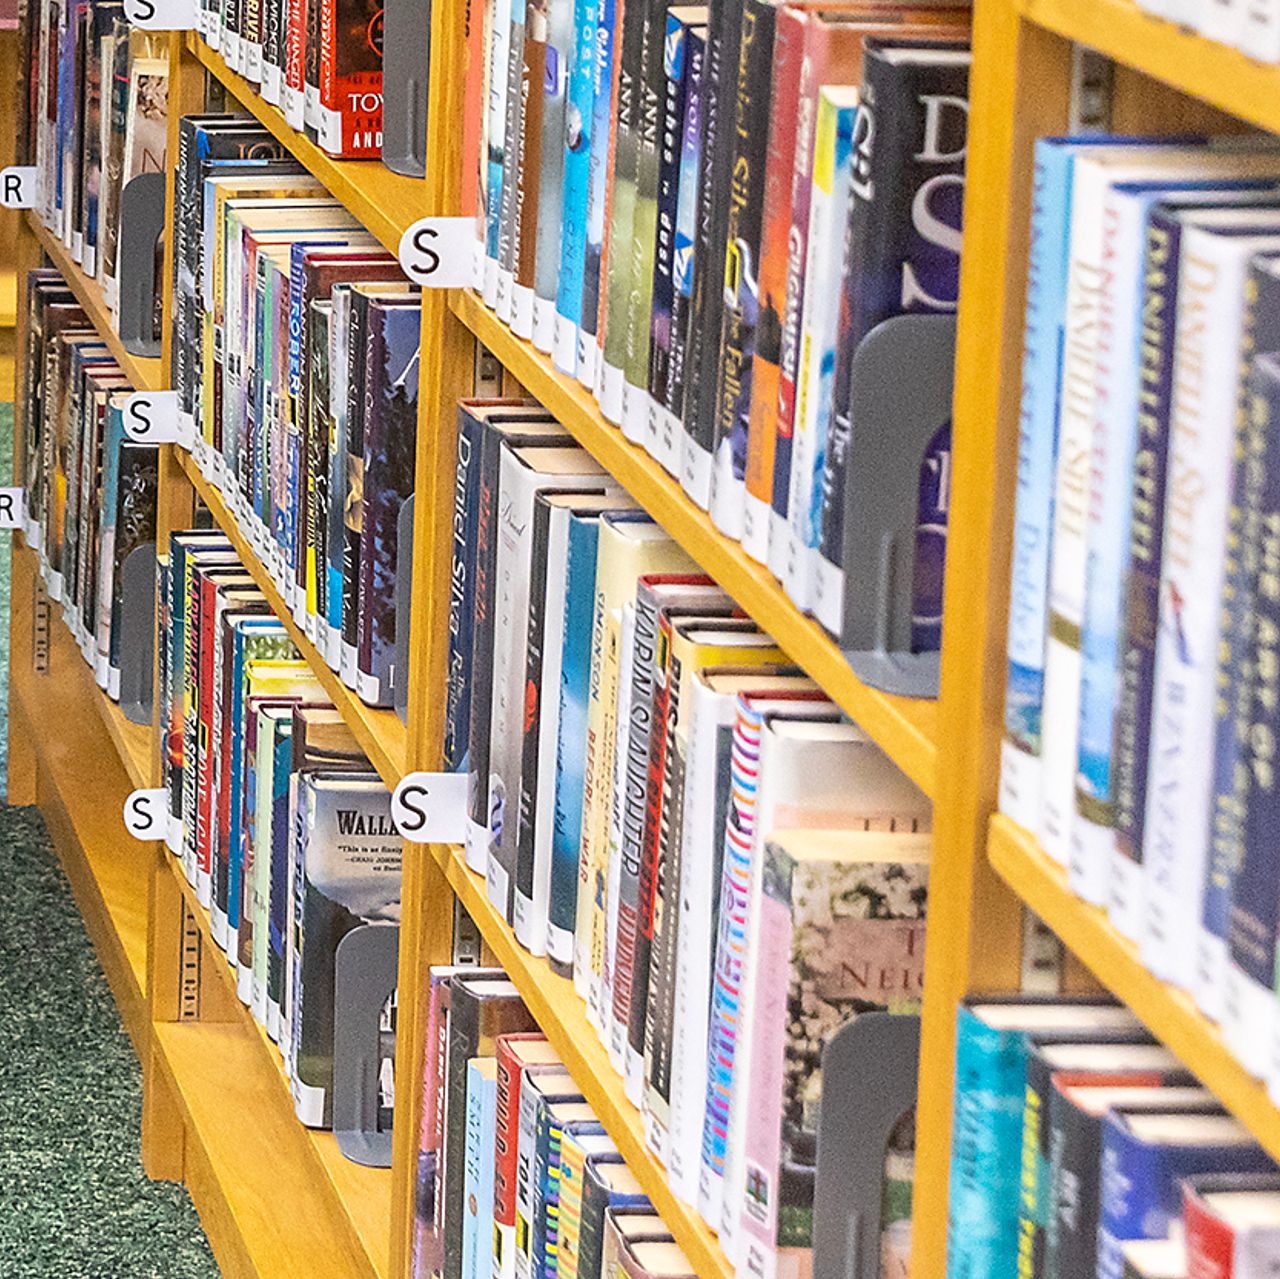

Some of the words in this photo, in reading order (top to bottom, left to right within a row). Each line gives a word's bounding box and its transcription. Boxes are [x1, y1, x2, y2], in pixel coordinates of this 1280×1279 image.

[641, 87, 657, 154] ANNE
[685, 103, 701, 155] SOUL
[3, 175, 24, 203] R
[409, 228, 440, 275] S
[779, 221, 805, 382] GILGAMESH
[1138, 224, 1169, 439] DANIELLE
[1178, 250, 1220, 419] DANIELLE
[129, 400, 152, 435] S
[451, 431, 473, 546] Daniel
[1132, 448, 1156, 561] STEEL
[1171, 453, 1204, 571] STEEL
[449, 555, 469, 638] Silva
[590, 591, 607, 703] SIMONSON
[631, 600, 658, 701] KARIN
[133, 797, 153, 830] S
[398, 786, 429, 832] S
[621, 704, 653, 878] SLAUGHTER
[518, 1152, 531, 1206] TOM
